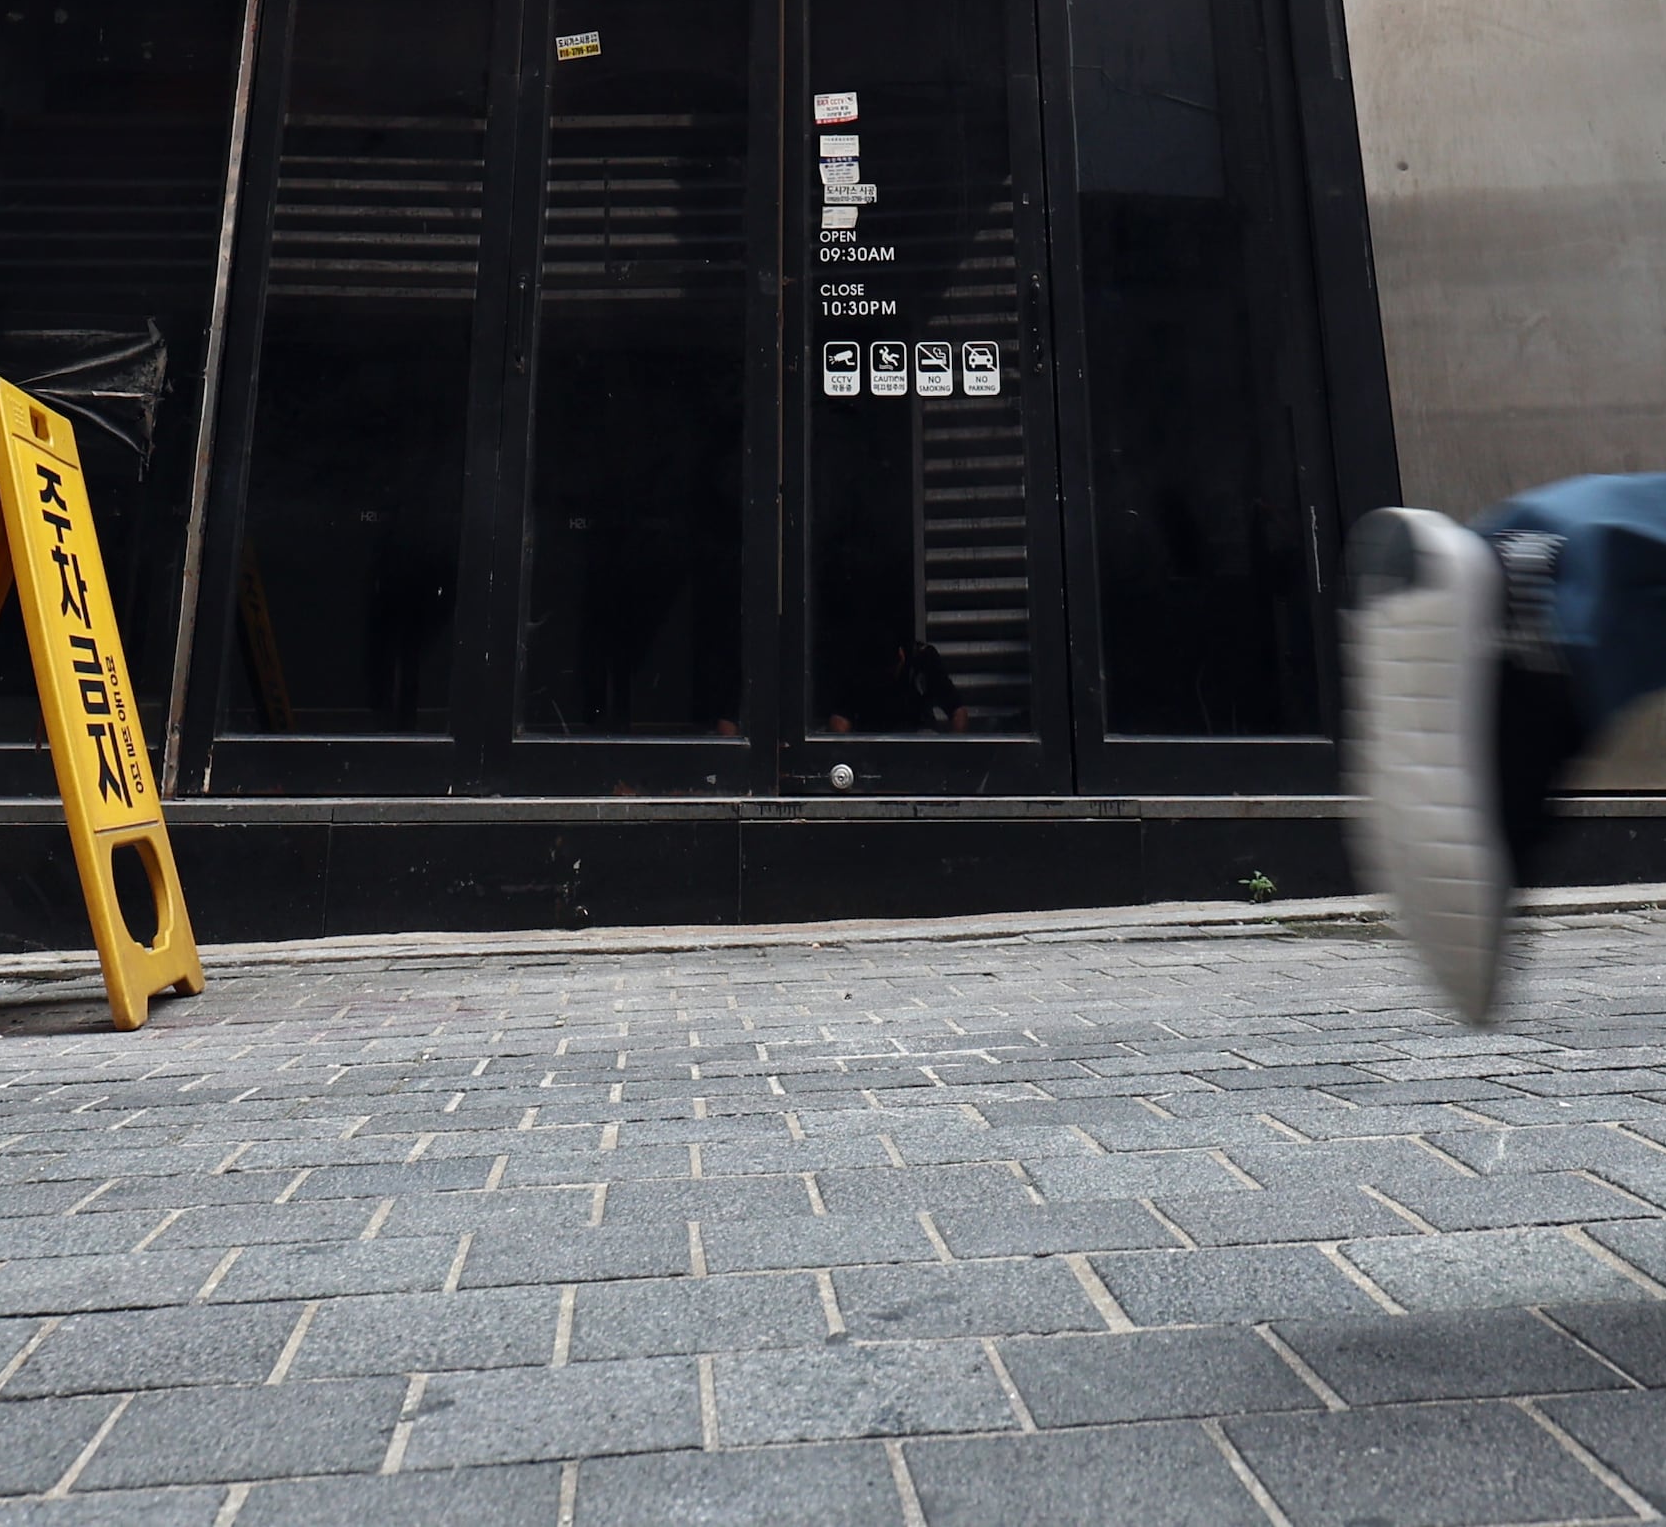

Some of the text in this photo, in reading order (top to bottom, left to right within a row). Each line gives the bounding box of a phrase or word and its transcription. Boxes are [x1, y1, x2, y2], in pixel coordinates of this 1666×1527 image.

[819, 230, 857, 243] OPEN
[819, 246, 896, 263] 09:30AM
[820, 283, 865, 297] CLOSE
[821, 300, 897, 316] 10:30PM
[831, 375, 853, 384] CCTV
[873, 375, 905, 384] CAUTION
[928, 376, 942, 384] NO
[975, 375, 989, 384] NO
[919, 384, 951, 393] SMOKING
[968, 384, 996, 392] PARKING
[35, 462, 134, 809] 주차금지
